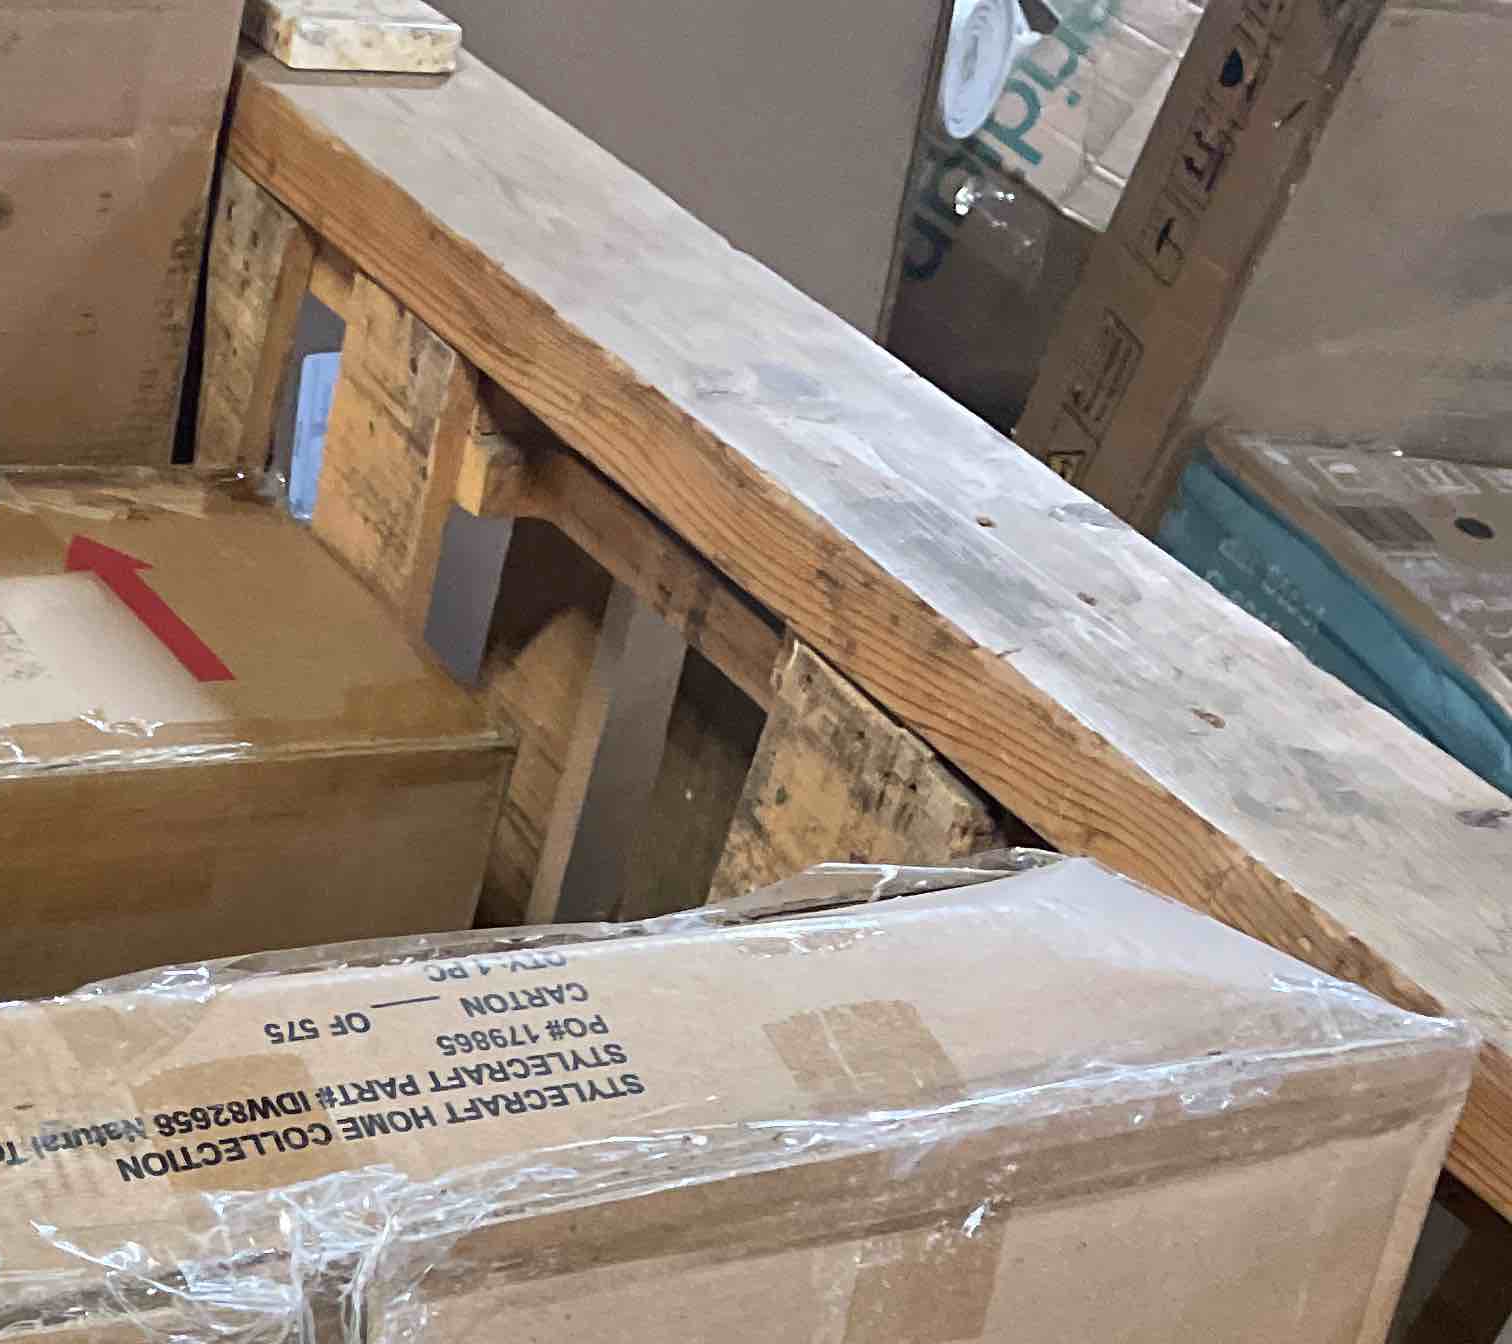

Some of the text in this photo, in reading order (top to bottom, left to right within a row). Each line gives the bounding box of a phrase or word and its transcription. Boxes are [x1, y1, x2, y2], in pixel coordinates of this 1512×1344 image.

[264, 982, 589, 1045] CARTON OF 575
[437, 1014, 610, 1057] PO# 179865
[430, 1043, 628, 1092] STYLECRAFT
[316, 1073, 421, 1110] PART#
[32, 1117, 147, 1158] Natural
[116, 1073, 646, 1182] STYLECRAFT HOME COLLECTION
